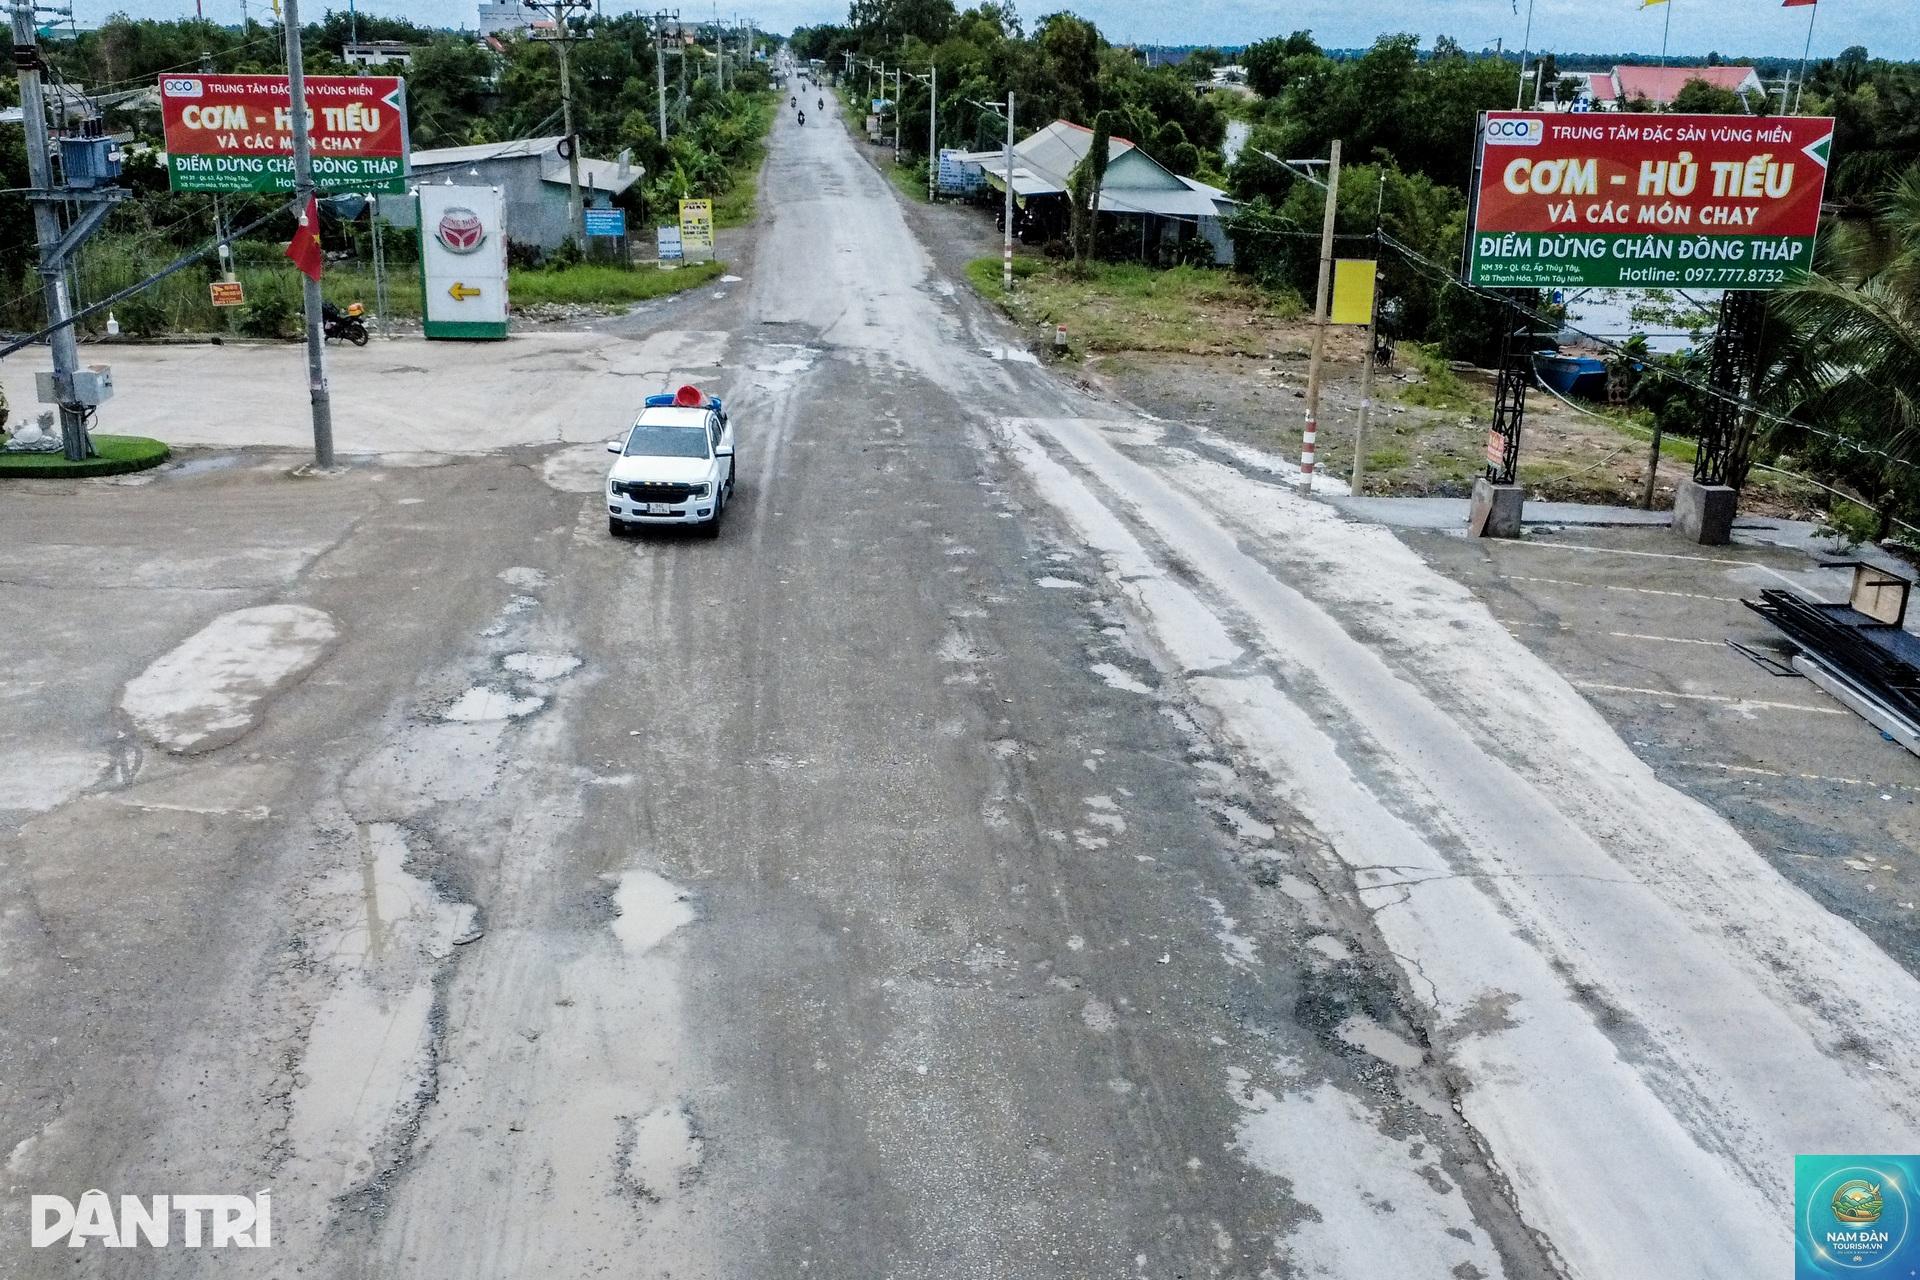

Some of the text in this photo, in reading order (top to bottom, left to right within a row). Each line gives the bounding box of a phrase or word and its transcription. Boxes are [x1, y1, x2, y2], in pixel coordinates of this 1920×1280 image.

[208, 84, 244, 94] TRUNG
[246, 82, 268, 94] TÂM
[271, 83, 291, 95] ĐẶC
[316, 84, 345, 95] VÙNG
[349, 83, 373, 95] MIỀN
[182, 105, 249, 130] CƠM
[322, 102, 380, 132] TIẾU
[1488, 122, 1540, 137] OCOP
[1552, 124, 1792, 143] TRUNG TÂM ĐẶC SẢN VÙNG MIỀN
[217, 133, 362, 150] VÀ CÁC MN CHAY
[176, 153, 398, 174] ĐIỂM DỪNG CHÂ ĐỒNG THÁP
[1503, 151, 1795, 199] CƠM - HỦ TIẾU
[1547, 199, 1760, 225] VÀ CÁC MÓN CHAY
[1479, 232, 1803, 261] ĐIỂM DỪNG CHÂN ĐỒNG THÁP
[1481, 263, 1493, 271] KM
[1494, 263, 1503, 271] 39
[1509, 263, 1520, 272] QL
[1521, 263, 1532, 272] 62,
[1619, 267, 1784, 283] Hotline: 097.777.8732
[1480, 274, 1490, 282] Xã
[1552, 275, 1566, 284] Tây
[1567, 275, 1584, 283] Ninh
